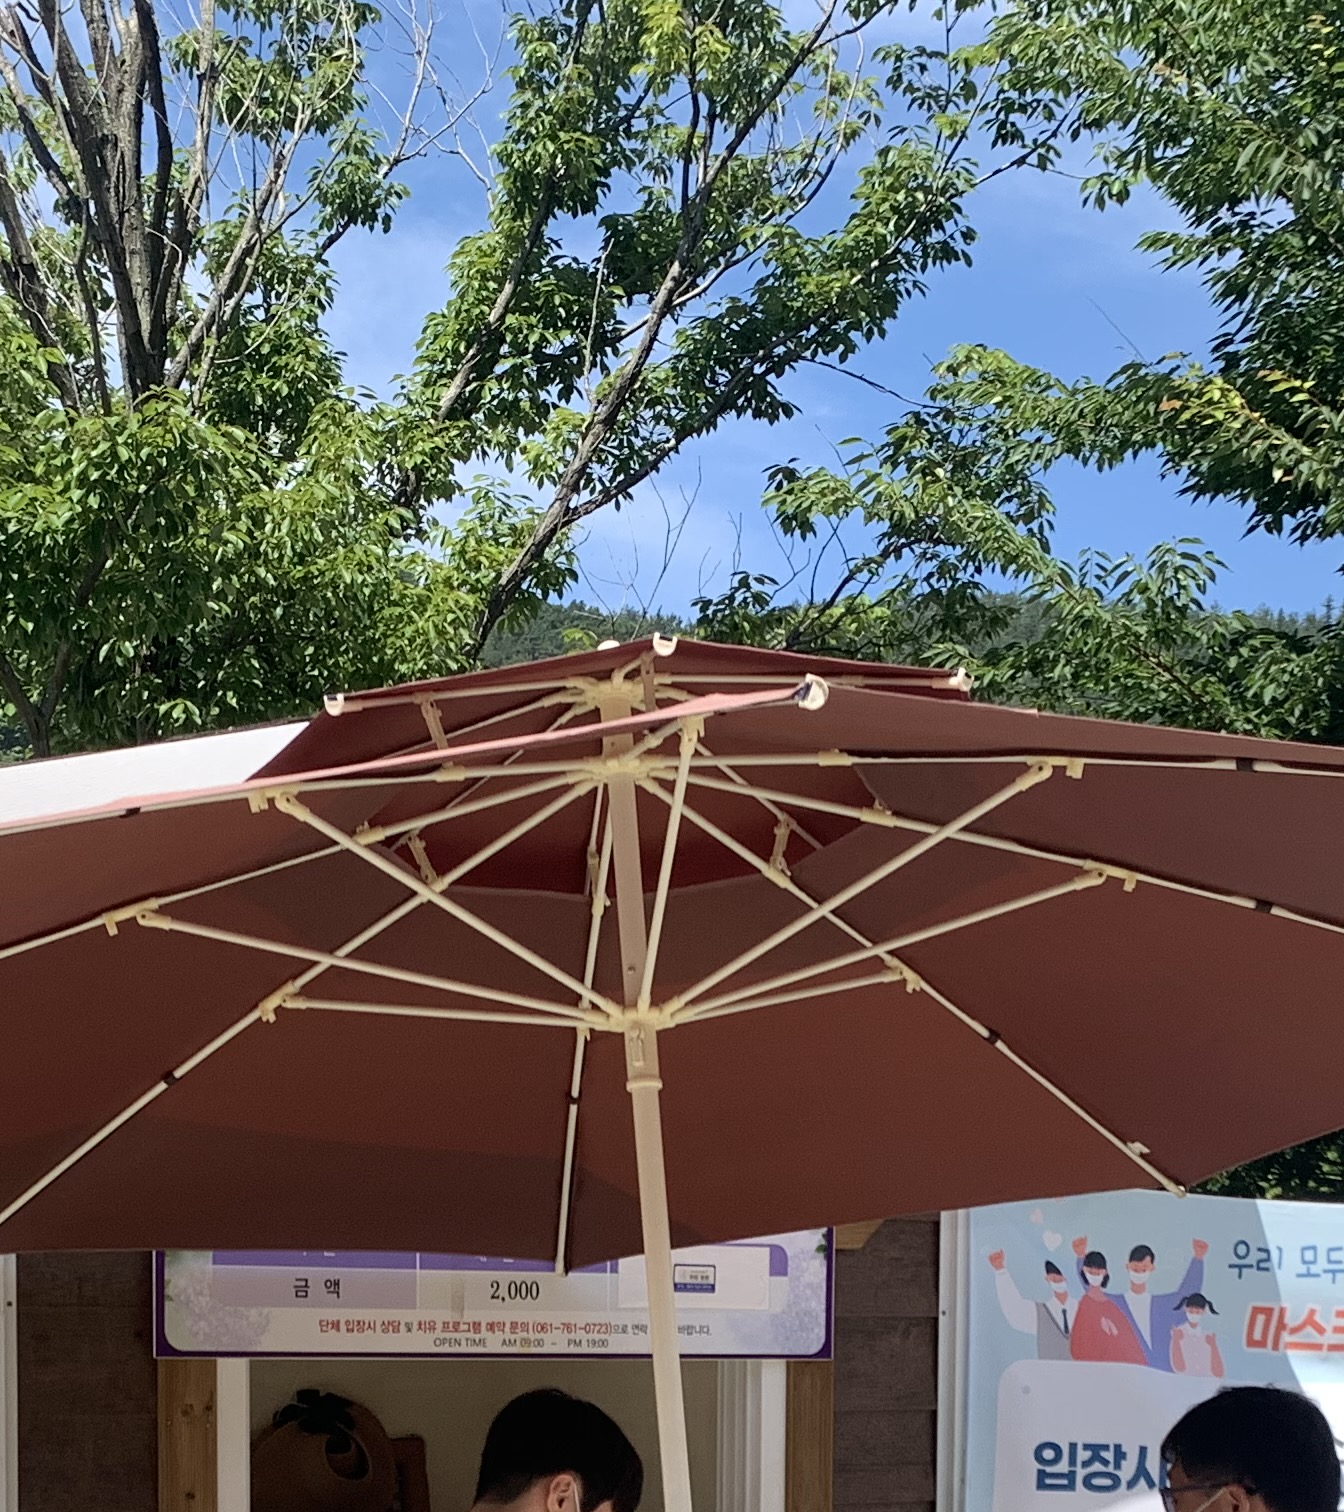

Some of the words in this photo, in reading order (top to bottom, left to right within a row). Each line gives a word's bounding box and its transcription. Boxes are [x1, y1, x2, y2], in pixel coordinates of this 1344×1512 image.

[1228, 1239, 1283, 1280] 우리
[490, 1280, 540, 1303] 2,000
[319, 1319, 341, 1333] 단체
[344, 1319, 376, 1333] 입장시
[380, 1319, 401, 1333] 상담
[405, 1321, 413, 1334] 및
[417, 1320, 437, 1334] 치유
[440, 1320, 481, 1334] 프로그램
[486, 1321, 506, 1334] 예약
[434, 1338, 462, 1348] OPEN
[465, 1338, 487, 1348] TIME
[501, 1339, 517, 1348] AM
[520, 1339, 544, 1348] 09:00
[567, 1339, 582, 1348] PM
[586, 1339, 609, 1348] 19:00
